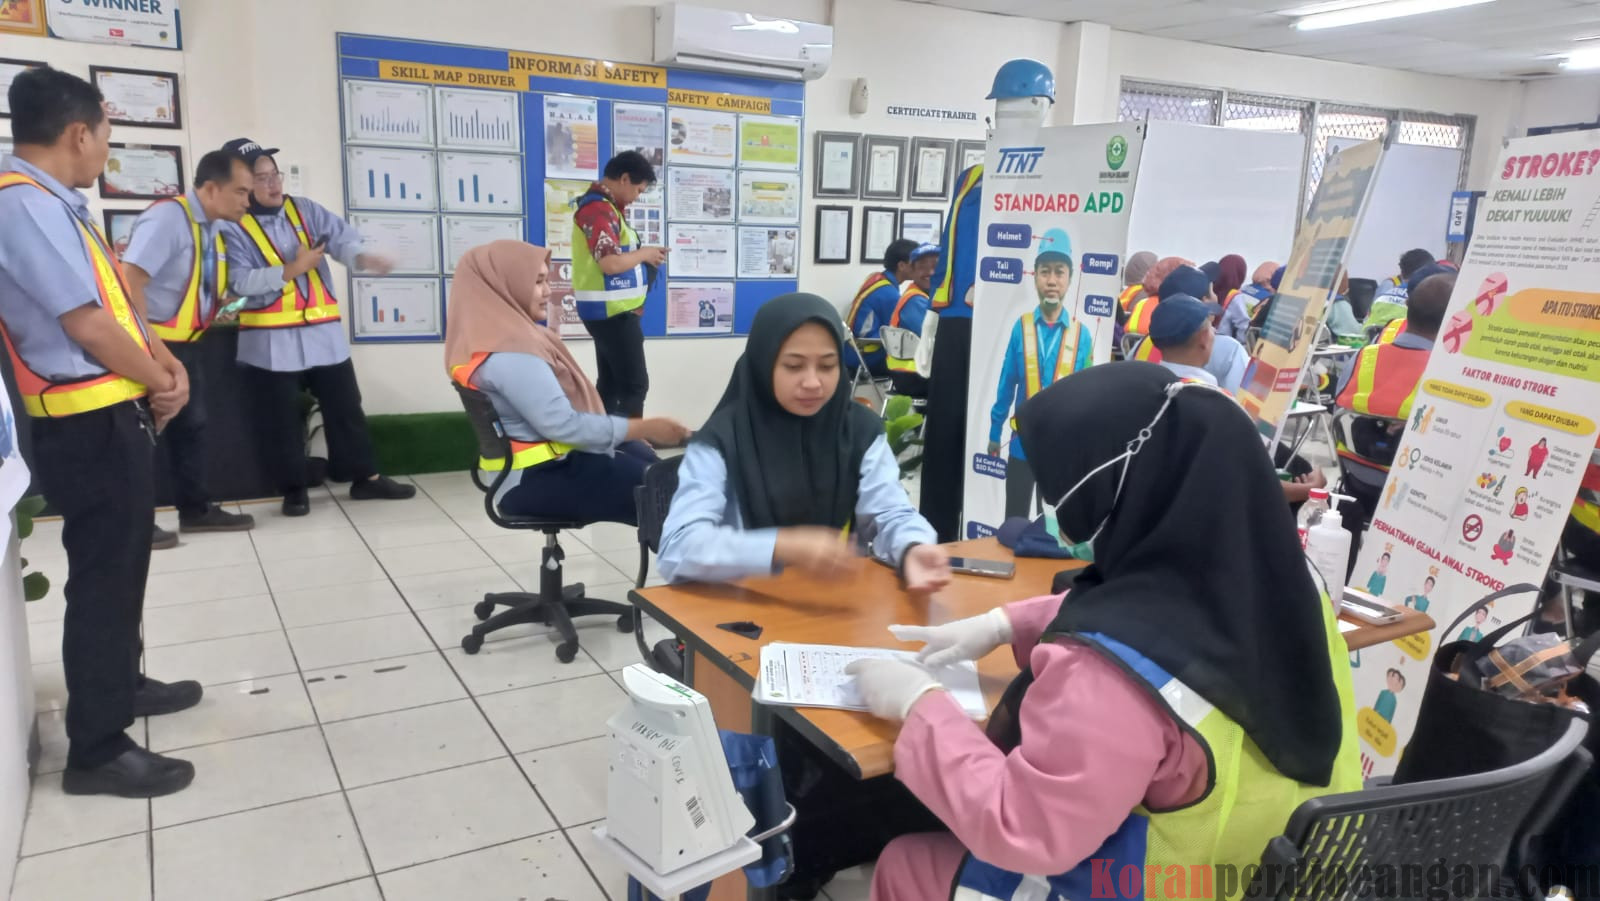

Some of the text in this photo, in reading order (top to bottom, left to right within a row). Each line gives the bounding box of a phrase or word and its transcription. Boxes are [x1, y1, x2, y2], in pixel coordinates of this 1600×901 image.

[391, 66, 516, 87] SKILL MAP DRIVER
[509, 56, 659, 84] INFORMASI SAFETY
[668, 92, 771, 111] SAFETY CAMPAIGN
[887, 106, 976, 121] CERTIFICATE TRAINER
[996, 147, 1045, 173] TTNT
[1501, 149, 1600, 180] STROKE?
[994, 192, 1124, 214] STANDARD APD
[1492, 188, 1567, 202] KENALI LEBIH
[1486, 210, 1521, 222] DEKAT
[997, 231, 1022, 241] Helmet
[997, 261, 1009, 270] Tali
[989, 271, 1015, 281] Helmet
[1541, 300, 1559, 315] APA
[1557, 302, 1572, 317] ITU
[1462, 366, 1558, 397] FAKTOR RISIKO STROKE
[1534, 410, 1556, 422] DAPAT
[1555, 415, 1579, 428] DIUBAH
[1373, 518, 1416, 548] PERHATIKAN
[1416, 540, 1441, 562] GEJALA
[1442, 555, 1465, 574] AWAL
[1465, 566, 1506, 592] STROKE!
